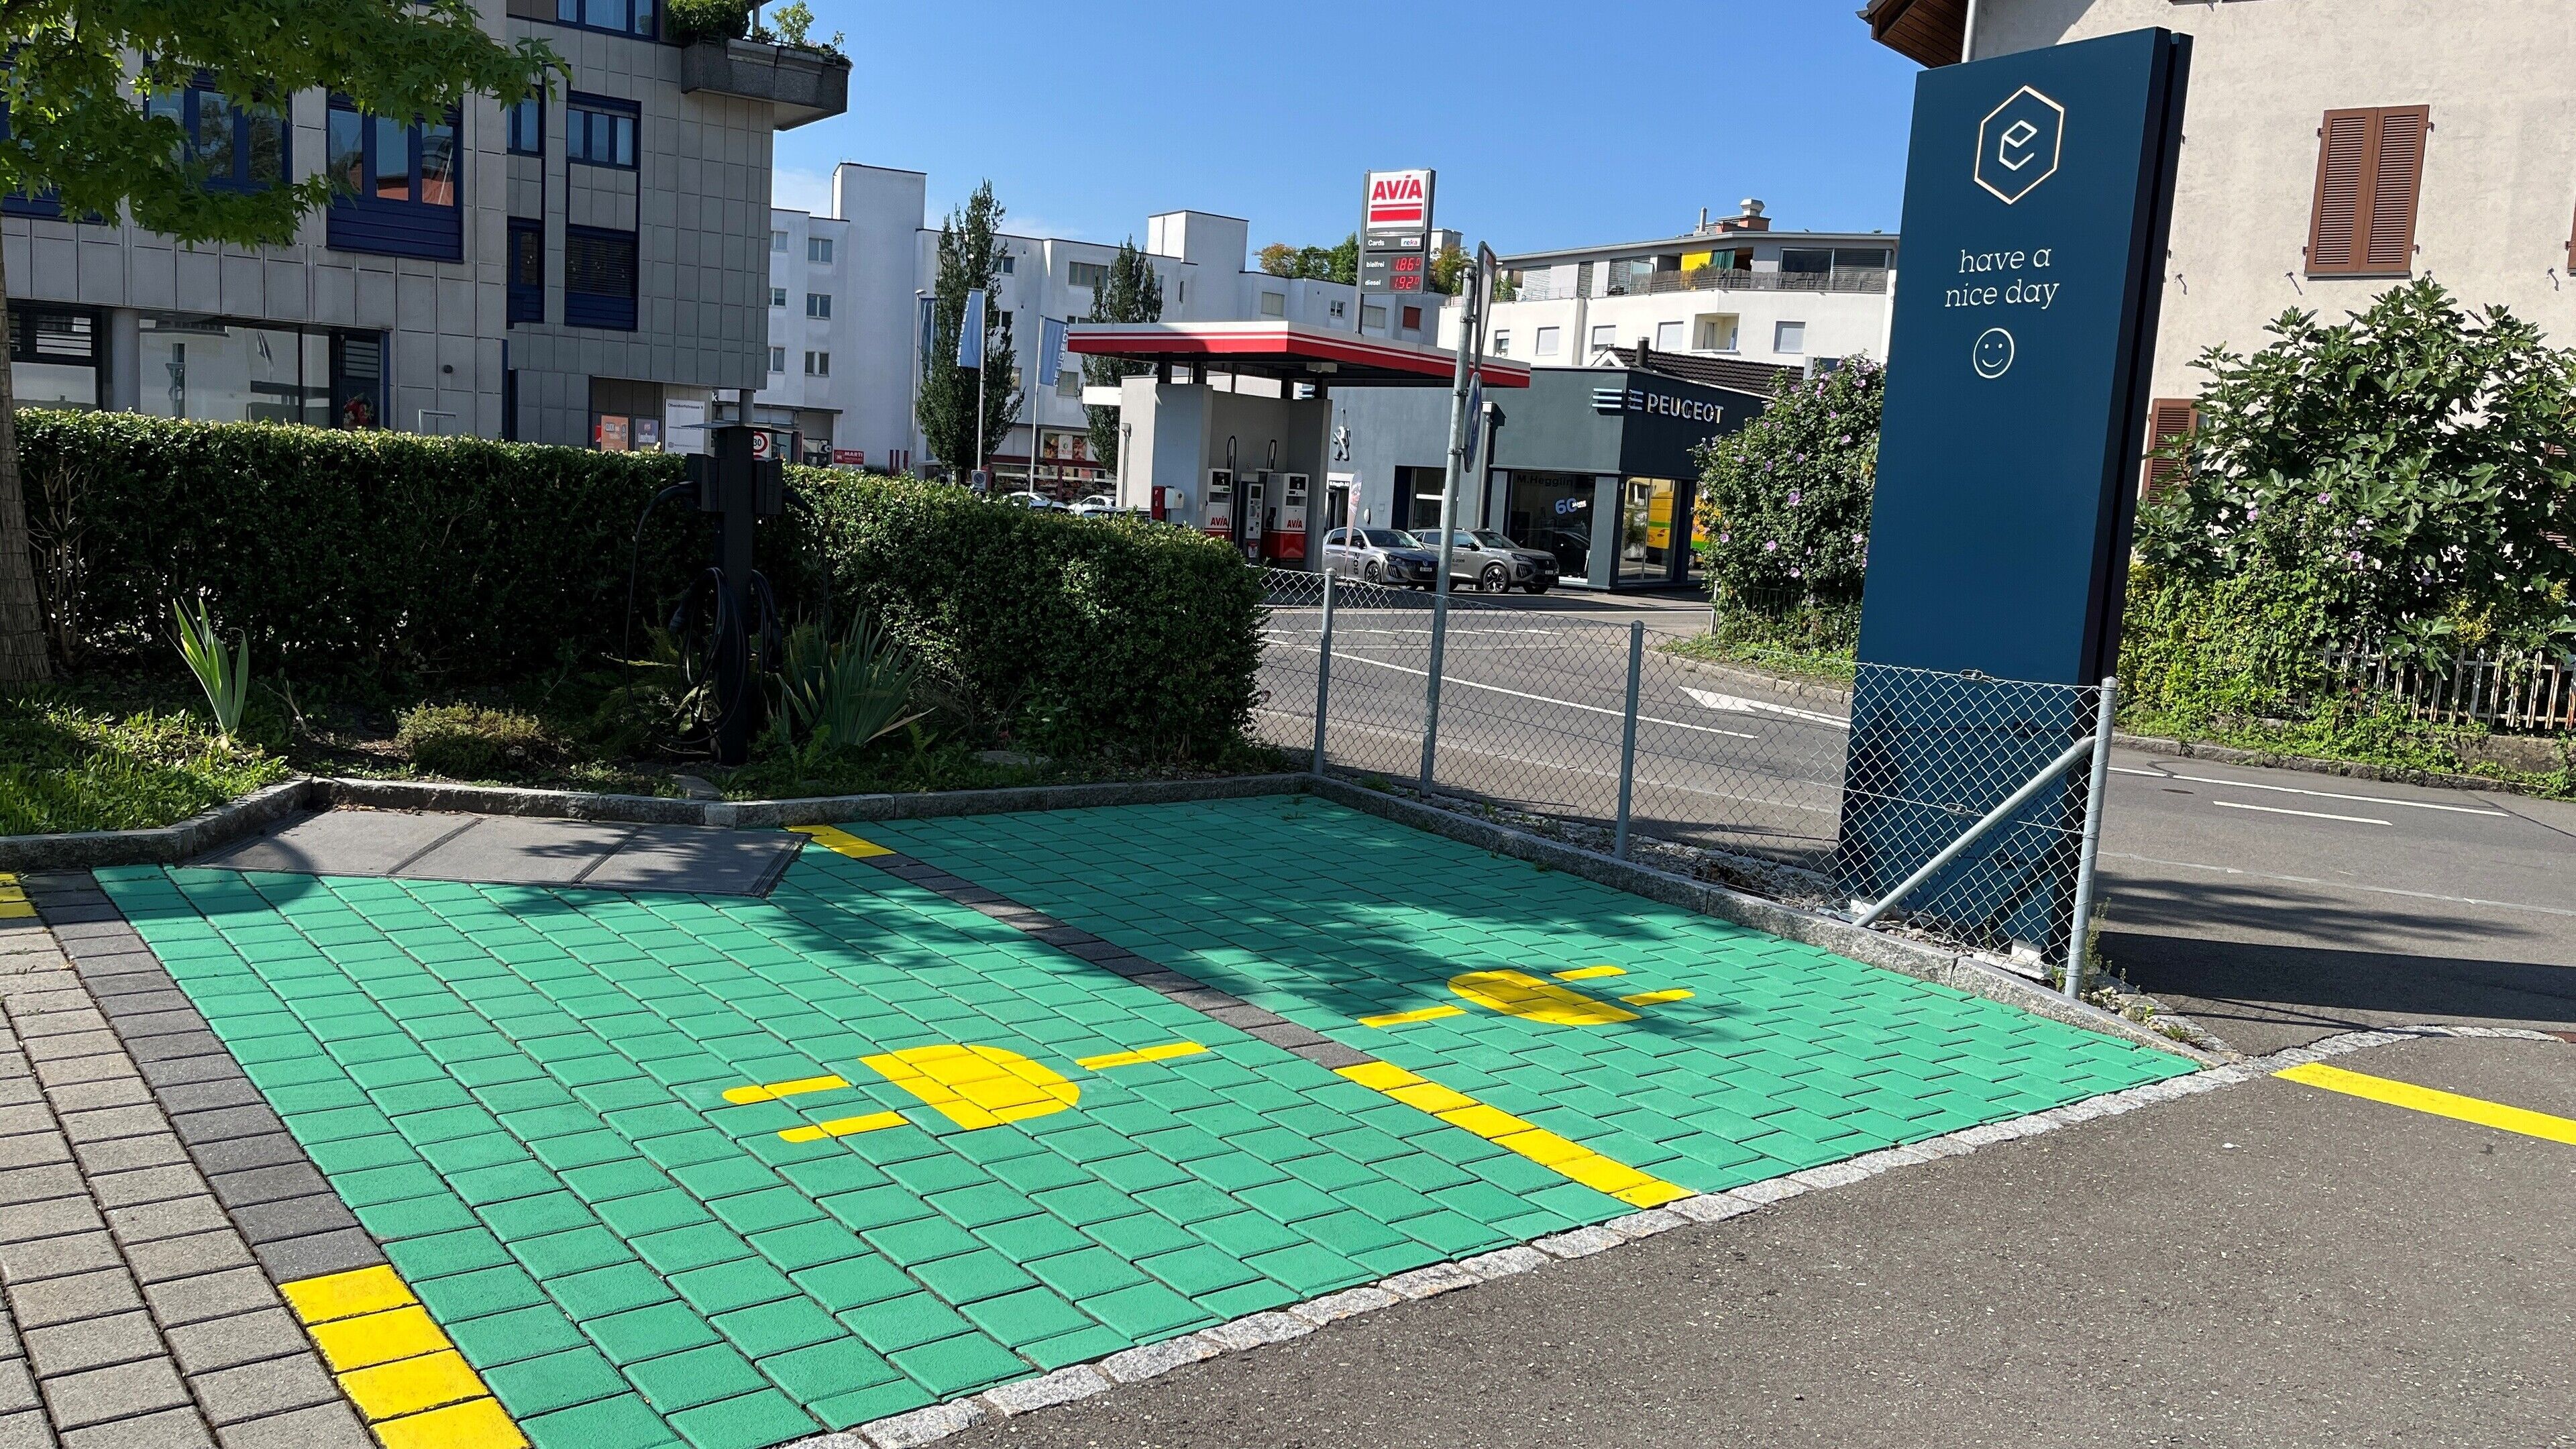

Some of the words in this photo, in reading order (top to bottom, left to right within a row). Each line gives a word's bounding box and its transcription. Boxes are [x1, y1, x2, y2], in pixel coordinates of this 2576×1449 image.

[1958, 249, 2025, 273] have
[2033, 248, 2052, 268] a
[1944, 282, 1998, 307] nice
[2005, 278, 2060, 310] day
[1053, 324, 1069, 387] PEUGEOT
[1647, 392, 1725, 424] PEUGEOT
[753, 439, 762, 447] 30
